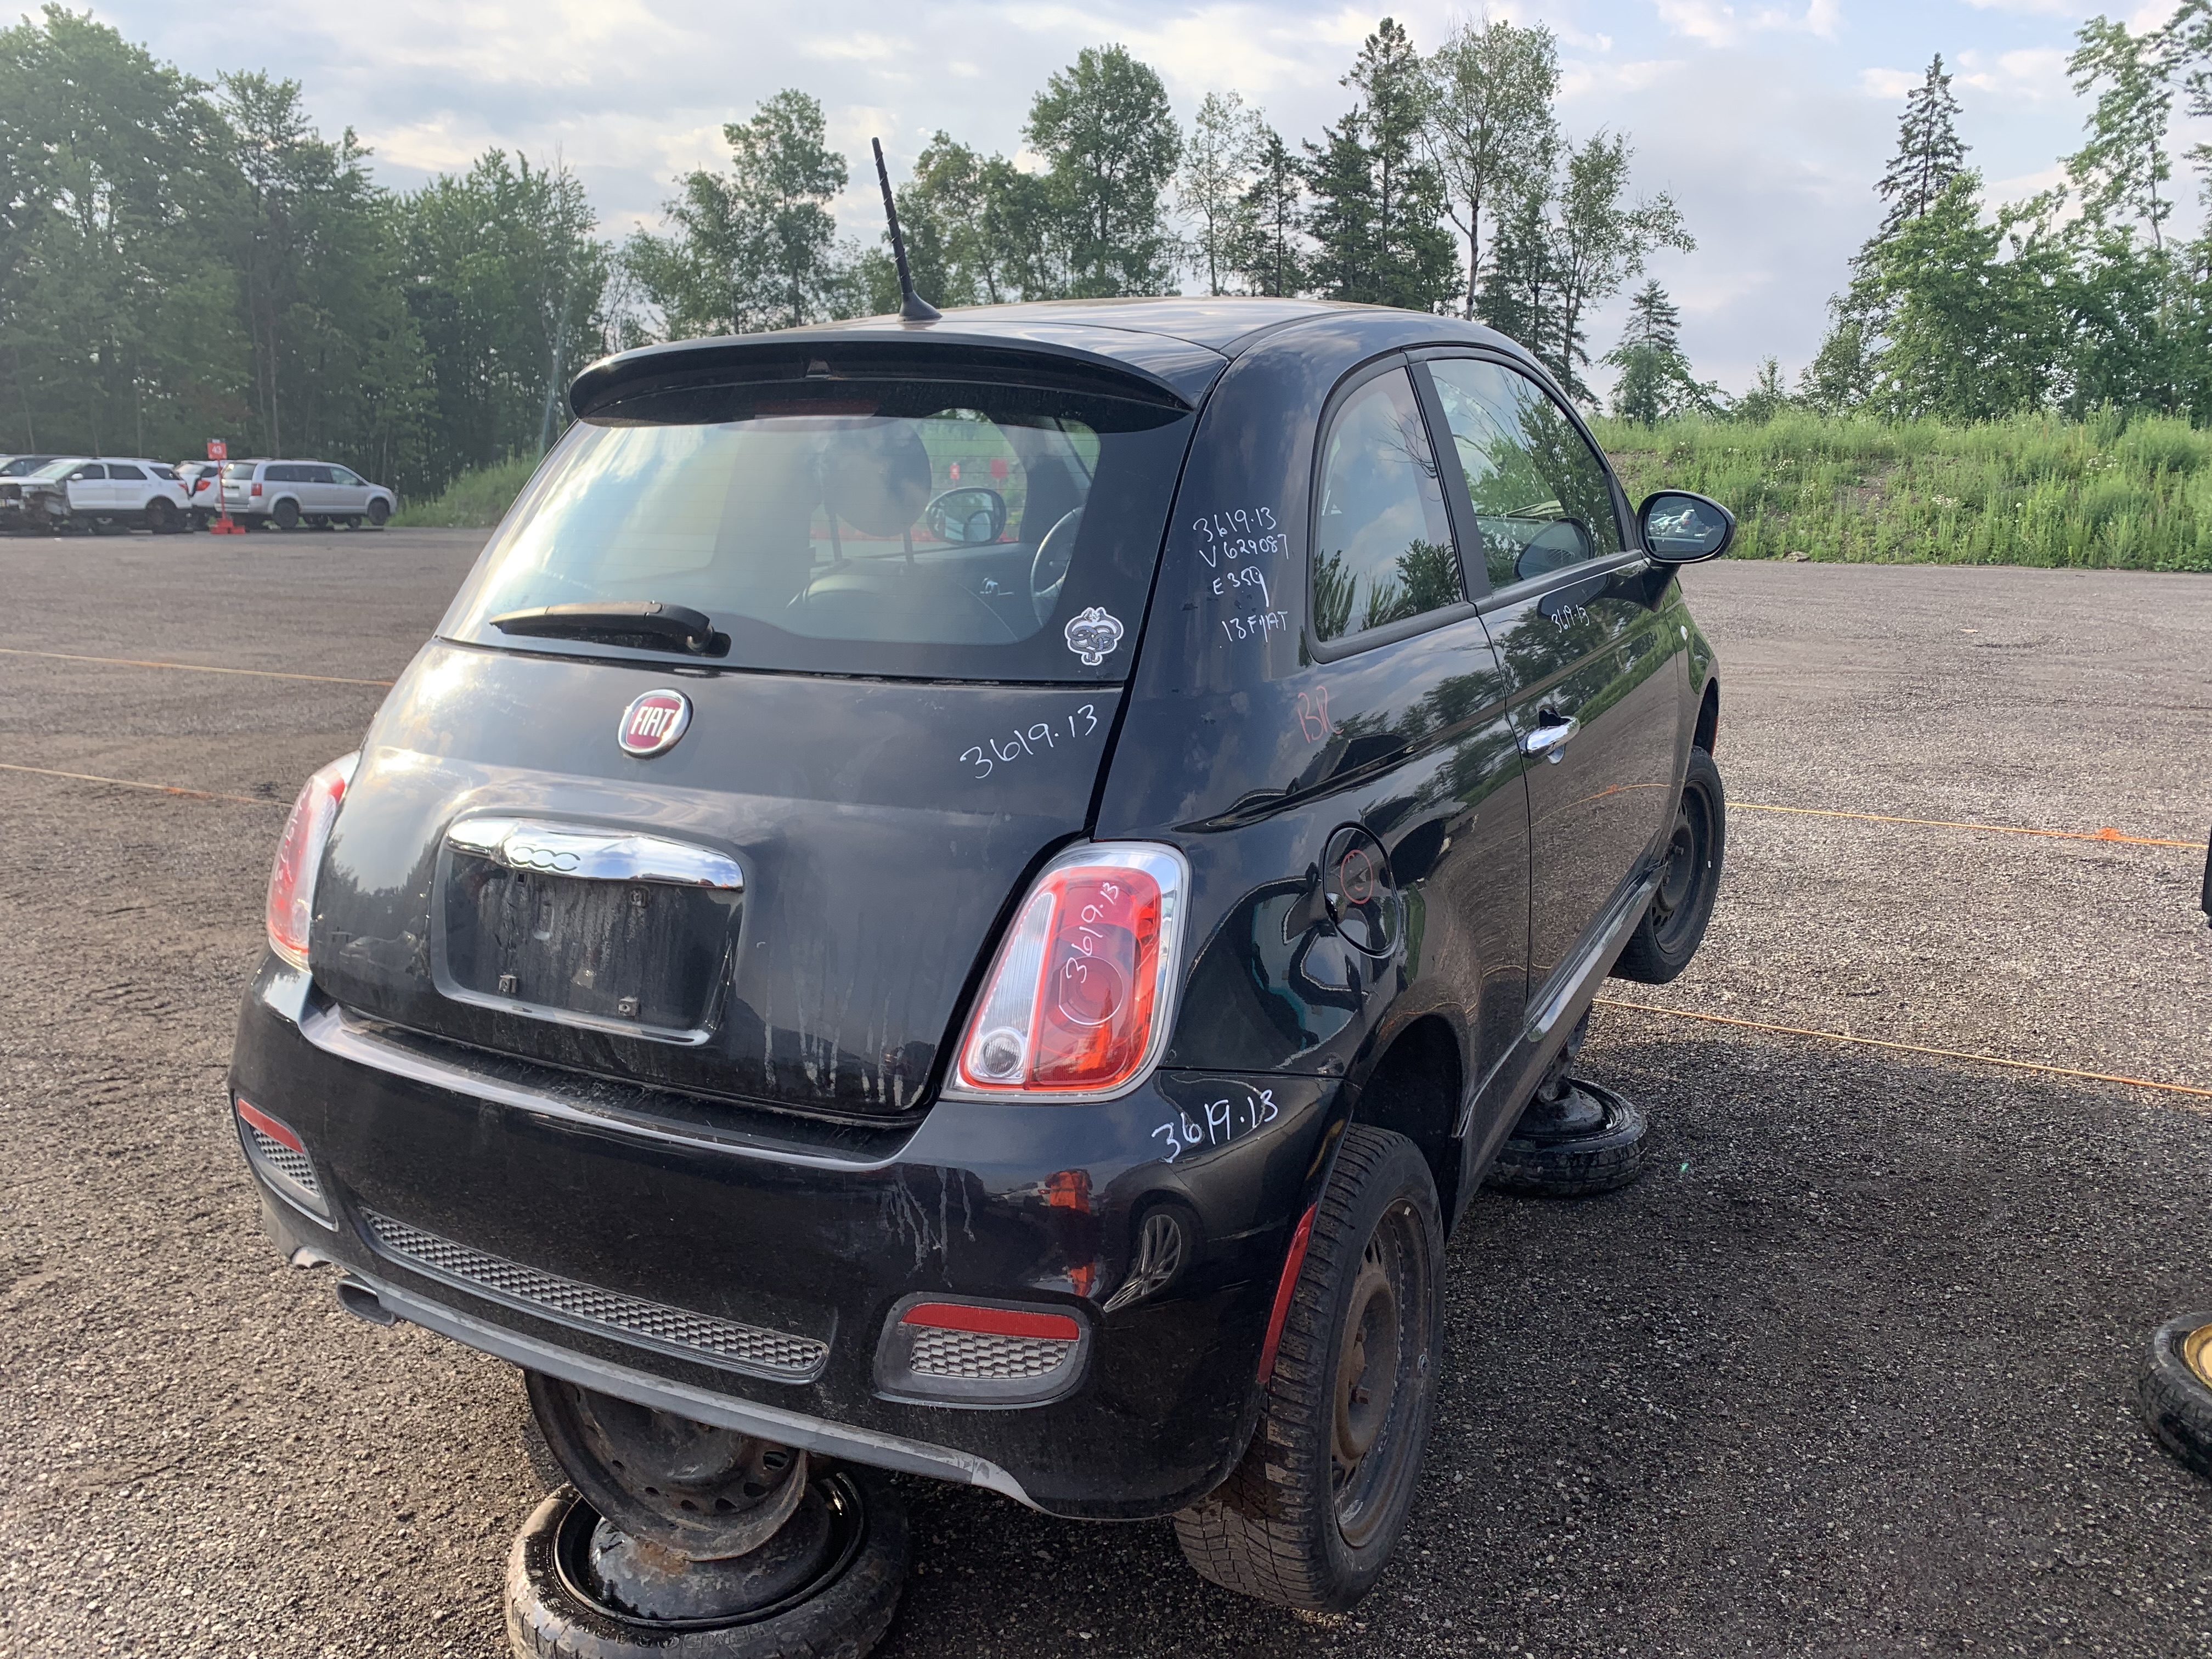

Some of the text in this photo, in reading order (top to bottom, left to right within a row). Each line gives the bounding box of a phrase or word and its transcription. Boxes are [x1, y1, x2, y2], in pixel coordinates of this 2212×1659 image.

[1193, 507, 1276, 543] 3619.13
[1551, 604, 1590, 634] 3619.13
[630, 706, 675, 738] FIAT
[960, 704, 1097, 779] 3619.13
[1065, 882, 1120, 983] 3619.13
[1151, 1089, 1279, 1164] 3619.13
